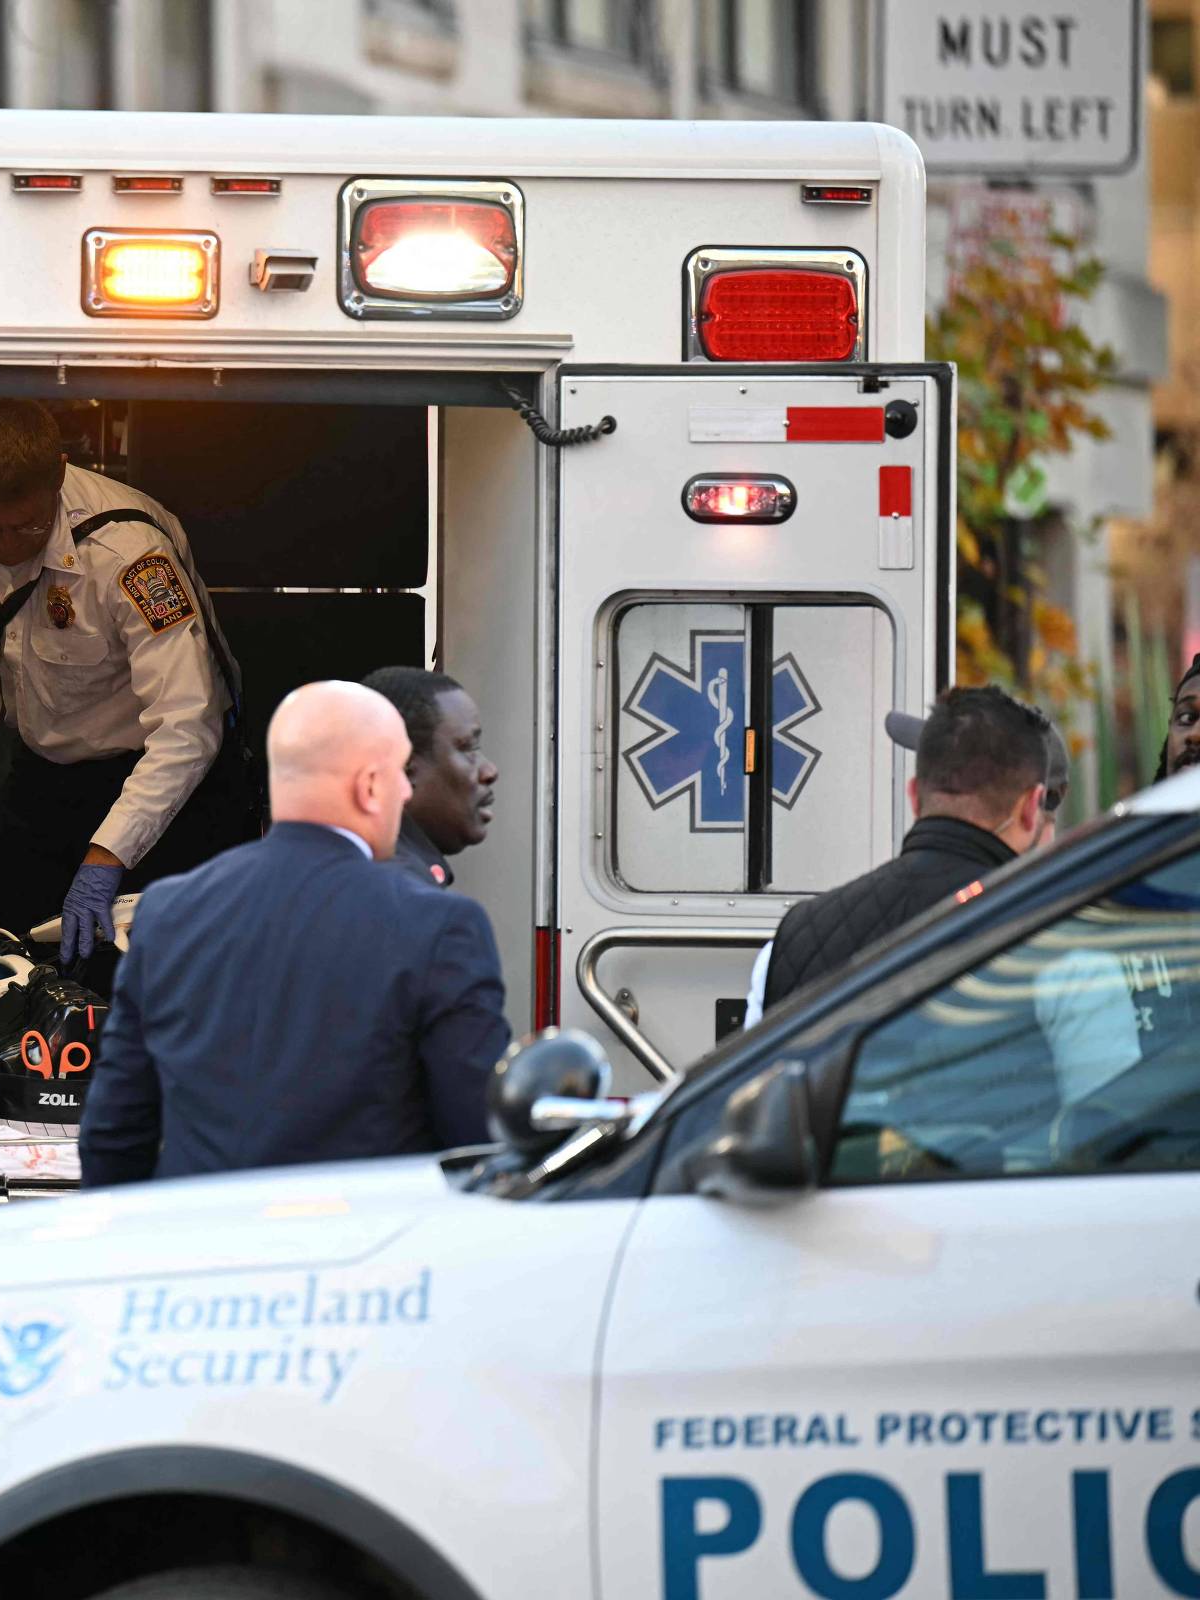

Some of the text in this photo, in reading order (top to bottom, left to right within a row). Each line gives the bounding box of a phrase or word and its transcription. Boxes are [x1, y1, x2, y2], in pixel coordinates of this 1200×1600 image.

[937, 15, 1077, 69] MUST
[901, 97, 1116, 140] TURN LEFT
[139, 599, 157, 623] FIRE
[162, 611, 183, 626] AND
[38, 1092, 78, 1106] ZOLL
[117, 1266, 432, 1335] Homeland
[103, 1333, 359, 1404] Security
[654, 1412, 859, 1450] FEDERAL
[877, 1407, 1174, 1446] PROTECTIVE
